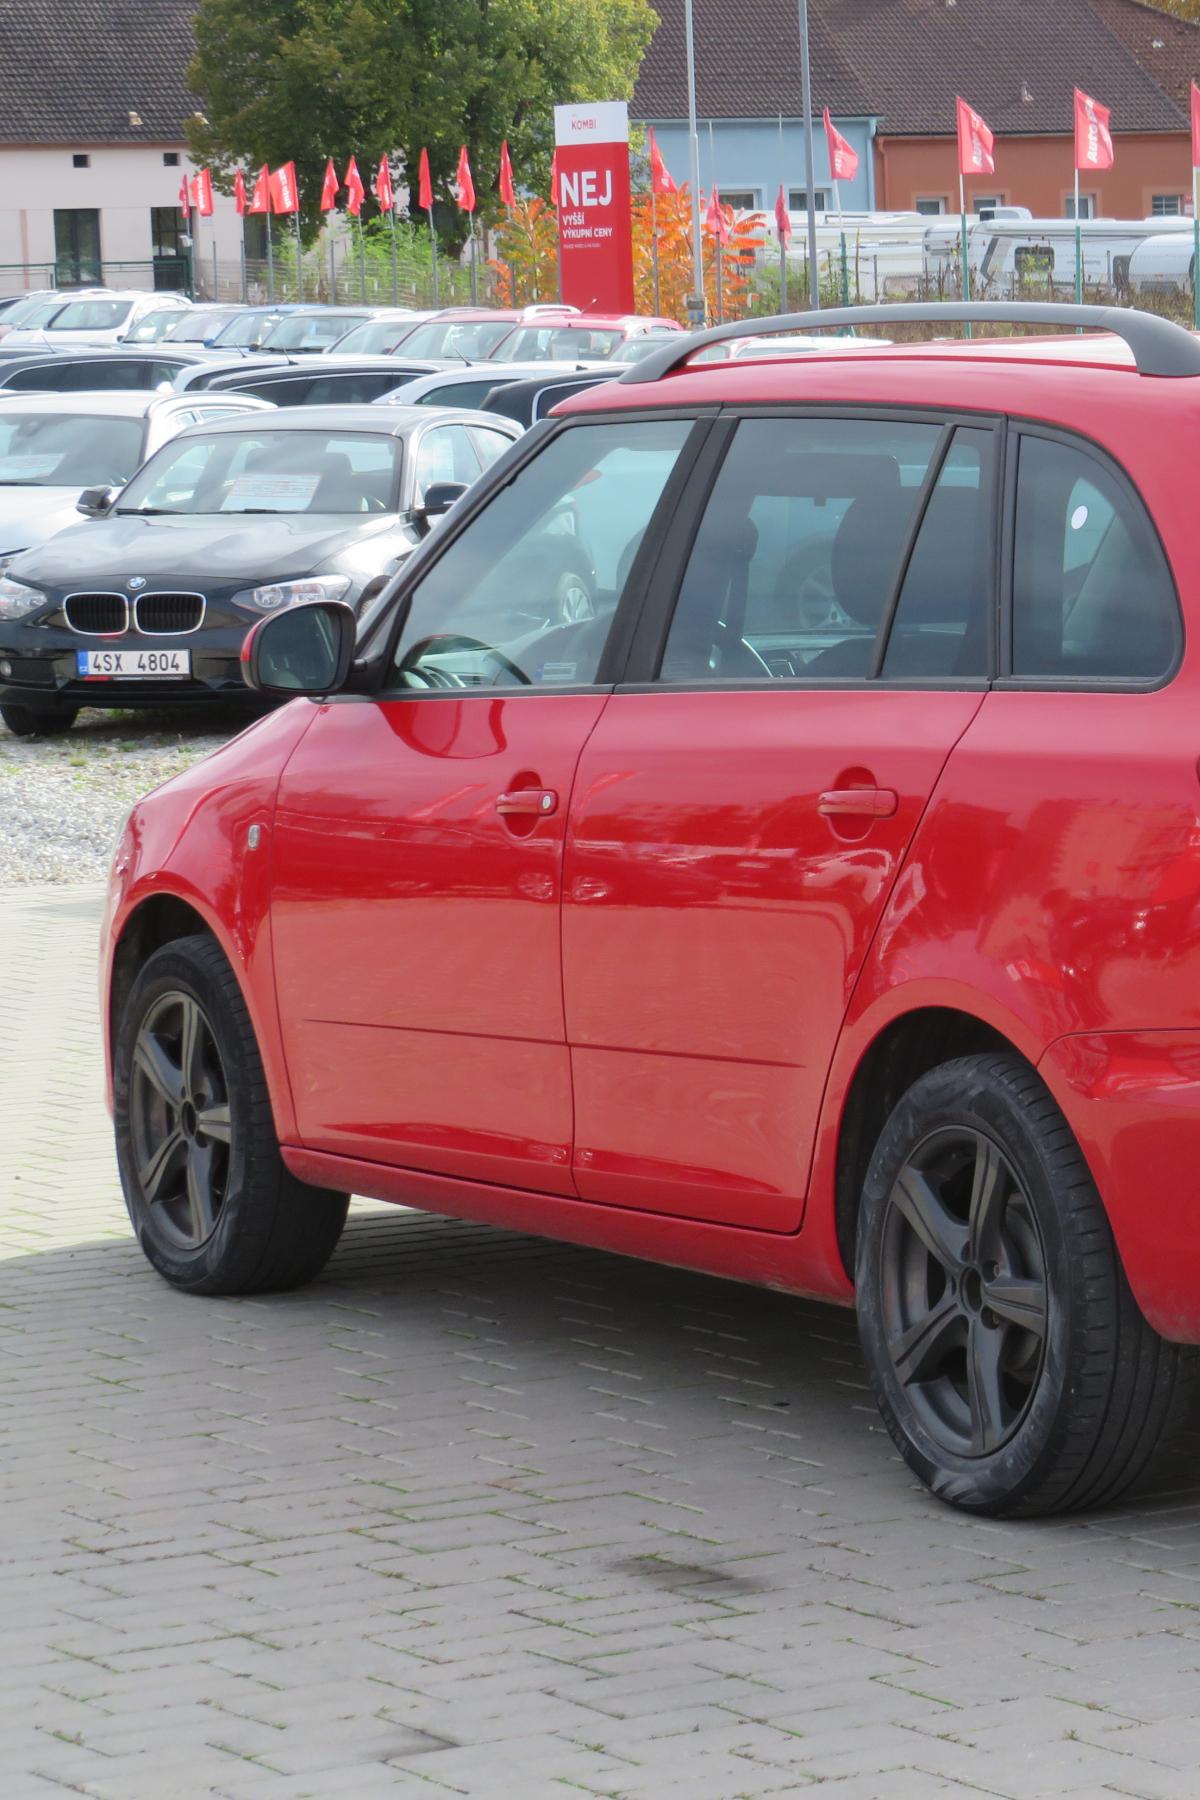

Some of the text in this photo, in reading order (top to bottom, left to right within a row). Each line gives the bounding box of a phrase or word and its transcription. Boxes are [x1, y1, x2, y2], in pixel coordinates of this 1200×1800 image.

[572, 119, 596, 130] KOMBI
[560, 170, 612, 207] NEJ
[562, 212, 584, 225] VYŠŠÍ
[562, 226, 612, 239] VÝKUPNÍ CENY
[93, 653, 180, 672] 4SX 4804
